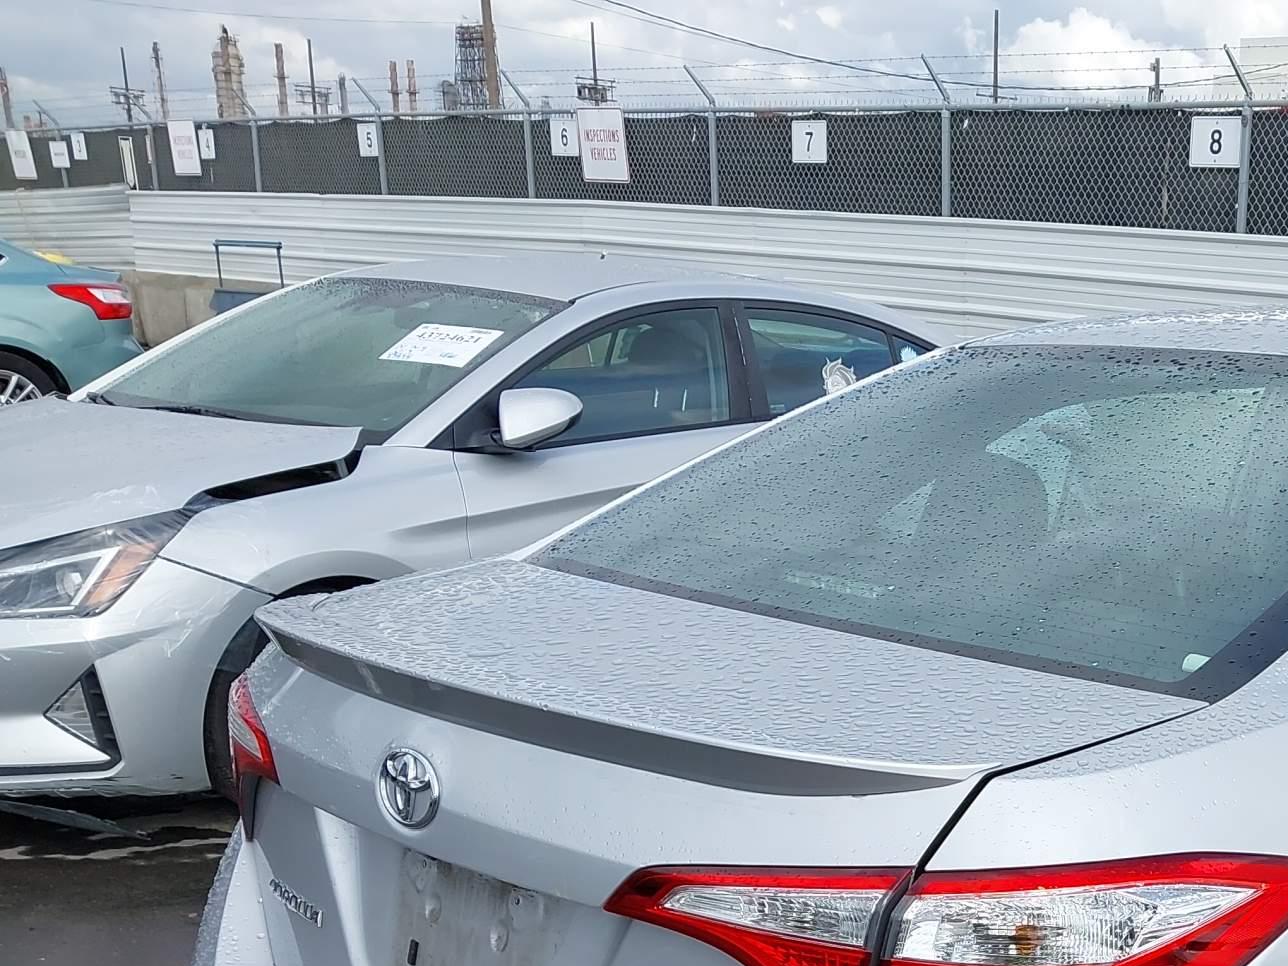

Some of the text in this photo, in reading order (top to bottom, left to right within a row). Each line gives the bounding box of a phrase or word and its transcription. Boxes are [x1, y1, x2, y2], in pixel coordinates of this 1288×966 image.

[366, 132, 372, 148] 5
[561, 128, 568, 146] 6
[584, 129, 620, 143] INSPECTIONS
[805, 132, 813, 152] 7
[1210, 129, 1222, 155] 8
[591, 148, 617, 161] VEHICLES
